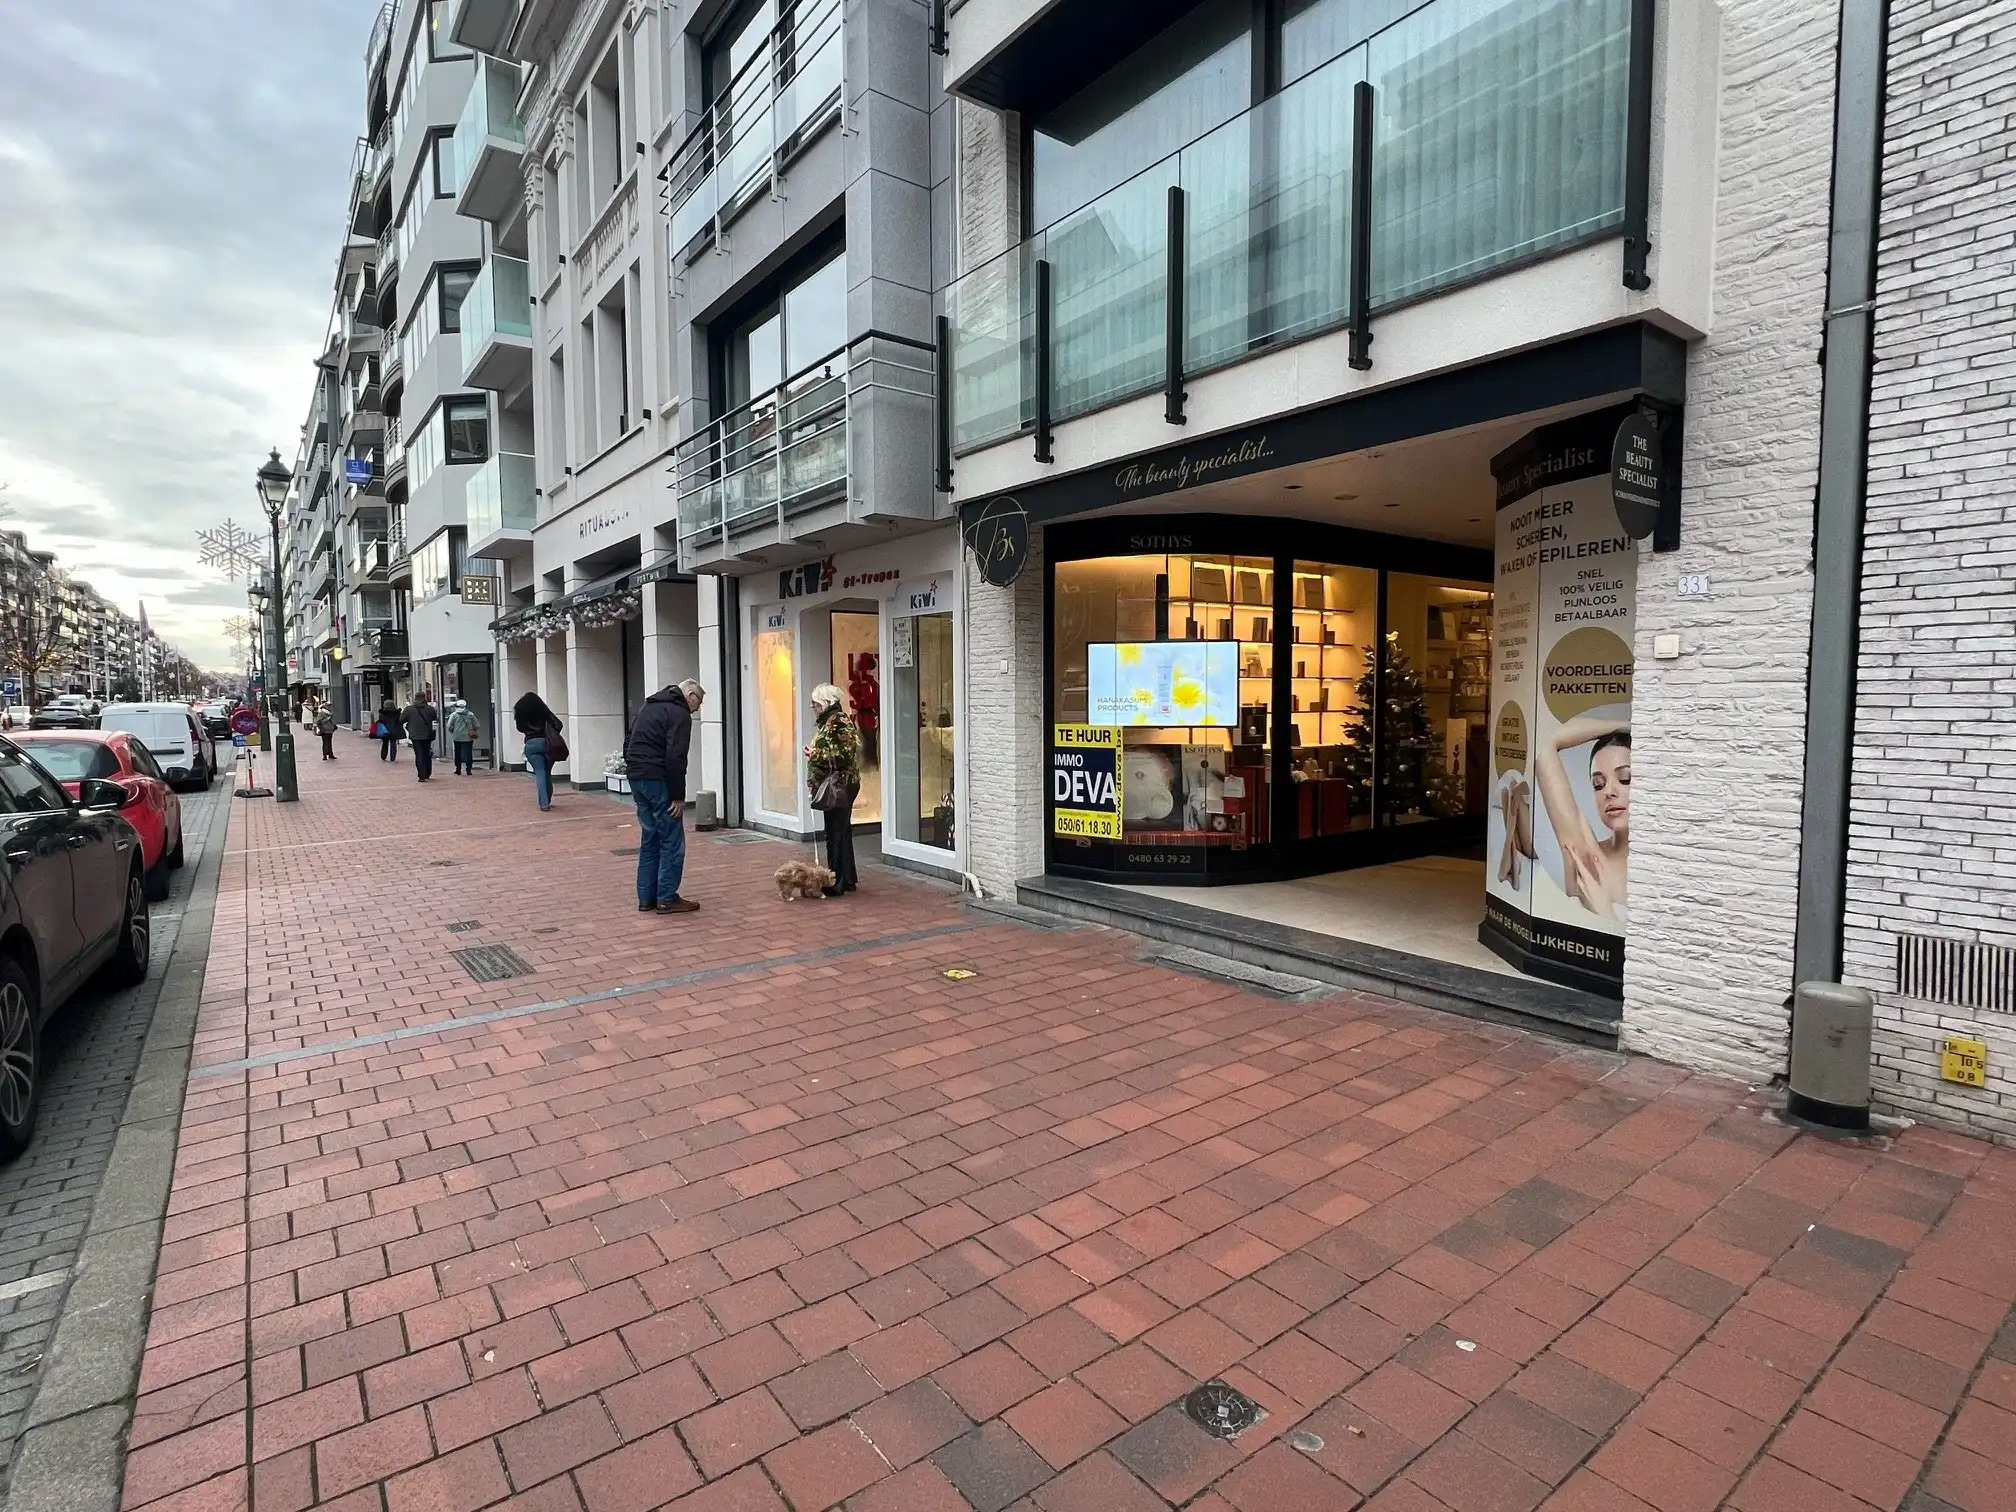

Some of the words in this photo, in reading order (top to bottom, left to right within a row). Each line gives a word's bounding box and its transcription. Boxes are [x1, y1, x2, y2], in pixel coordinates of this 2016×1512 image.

[1632, 434, 1648, 451] THE
[1523, 448, 1595, 488] Specialist
[1625, 451, 1654, 471] BEAUTY
[1115, 463, 1142, 492] The
[1145, 456, 1192, 488] beauty
[1618, 467, 1659, 490] SPECIALIST
[1509, 511, 1533, 534] NOOIT
[1534, 500, 1574, 520] MEER
[1130, 535, 1192, 549] SOTHYS
[1500, 559, 1526, 576] WAXEN
[1526, 552, 1538, 568] OF
[1539, 536, 1632, 564] EPILEREN!
[1577, 568, 1605, 580] SNEL
[1559, 584, 1586, 596] 100%
[1588, 579, 1624, 592] VEILIG
[1679, 576, 1709, 595] 331
[1564, 594, 1617, 608] PIJNLOOS
[1554, 607, 1627, 622] BETAALBAAR
[253, 671, 261, 680] P
[1546, 664, 1633, 677] VOORDELIGE
[4, 681, 13, 691] P
[1550, 682, 1627, 694] PAKKETTEN
[1097, 704, 1139, 712] PRODUCTS
[1058, 729, 1073, 741] TE
[1076, 729, 1111, 743] HUUR
[1054, 754, 1084, 767] IMMO
[1054, 769, 1117, 804] DEVA
[1058, 817, 1112, 836] 050/61.18.30
[1128, 853, 1152, 863] 0480
[1167, 854, 1178, 863] 29
[1180, 854, 1191, 864] 22
[1512, 921, 1610, 962] MOGELIJKHEDEN!
